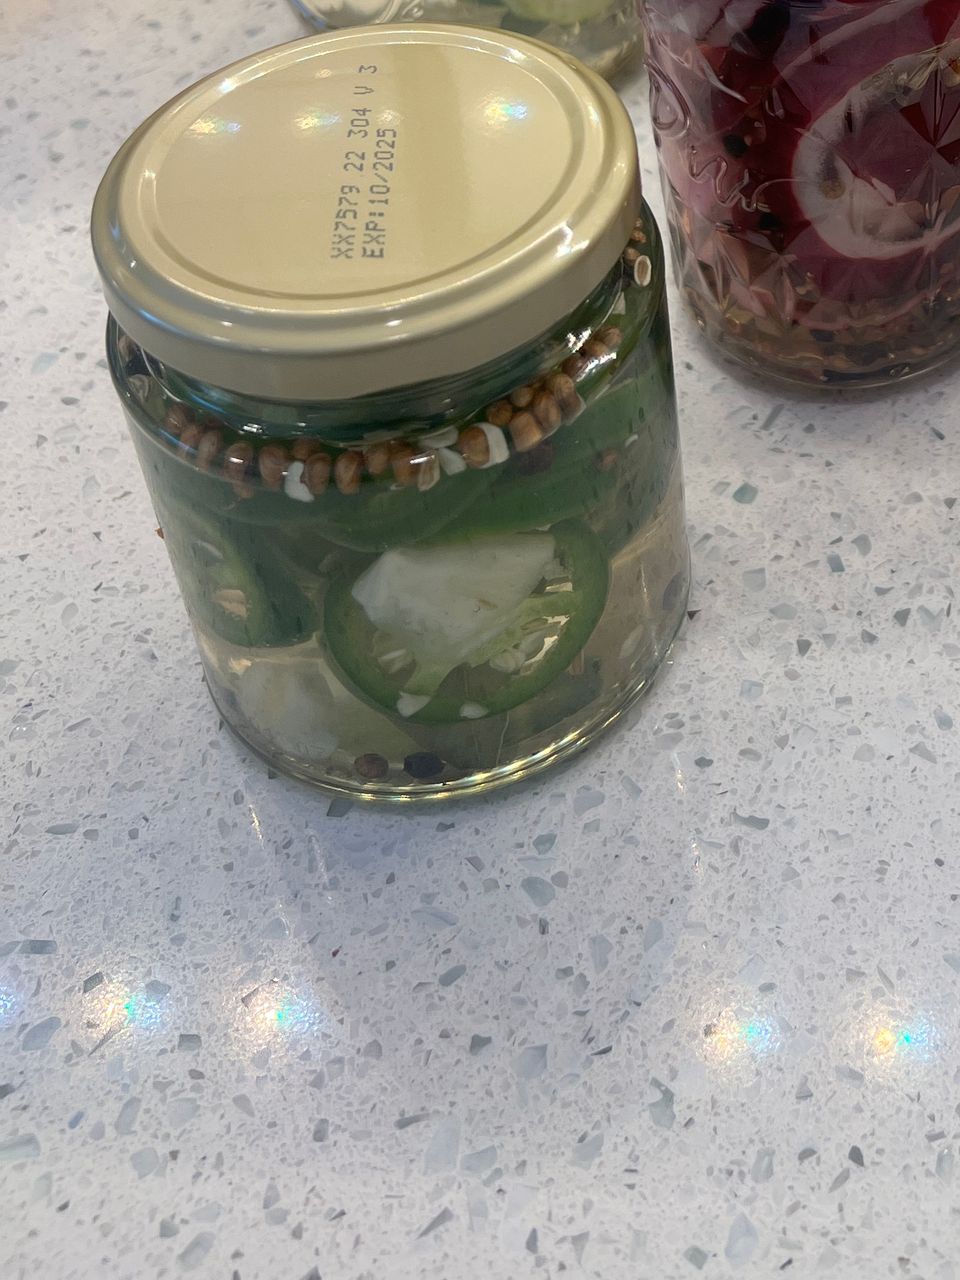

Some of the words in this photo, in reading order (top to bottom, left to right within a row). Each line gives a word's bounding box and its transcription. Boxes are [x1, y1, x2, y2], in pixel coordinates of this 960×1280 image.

[358, 64, 378, 74] 3
[347, 108, 372, 139] 304
[343, 150, 366, 172] 22
[361, 128, 397, 259] EXP:10/2025
[330, 185, 360, 259] XX7579
